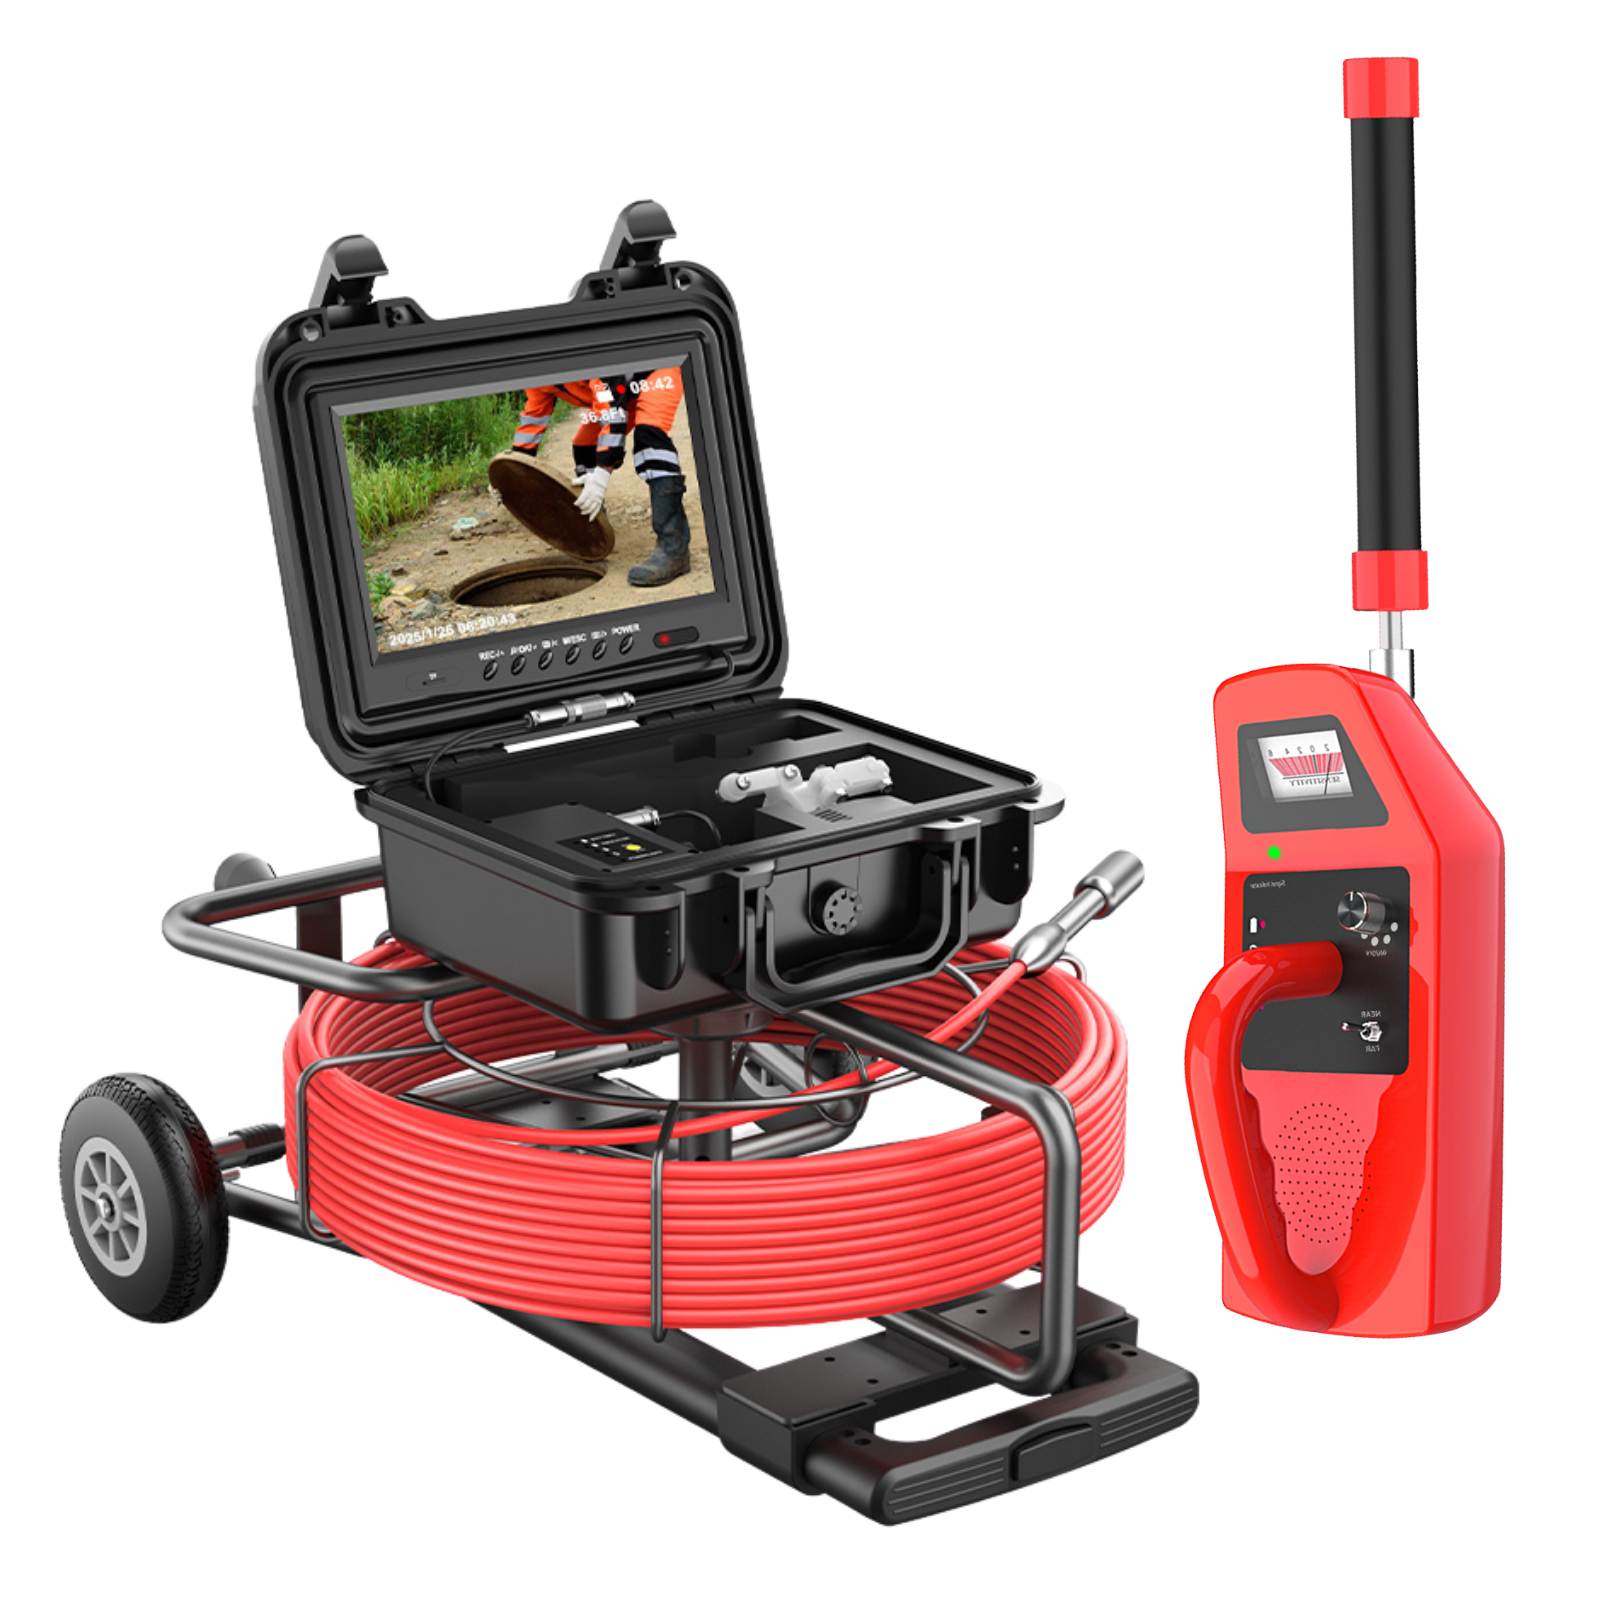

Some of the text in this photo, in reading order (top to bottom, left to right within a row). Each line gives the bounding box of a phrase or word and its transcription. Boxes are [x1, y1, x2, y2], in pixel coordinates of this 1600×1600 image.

[629, 376, 675, 394] 08:42
[580, 407, 626, 425] 36.8Ft
[389, 612, 517, 647] 2025/1/26 06:20:43
[611, 623, 641, 636] POWER
